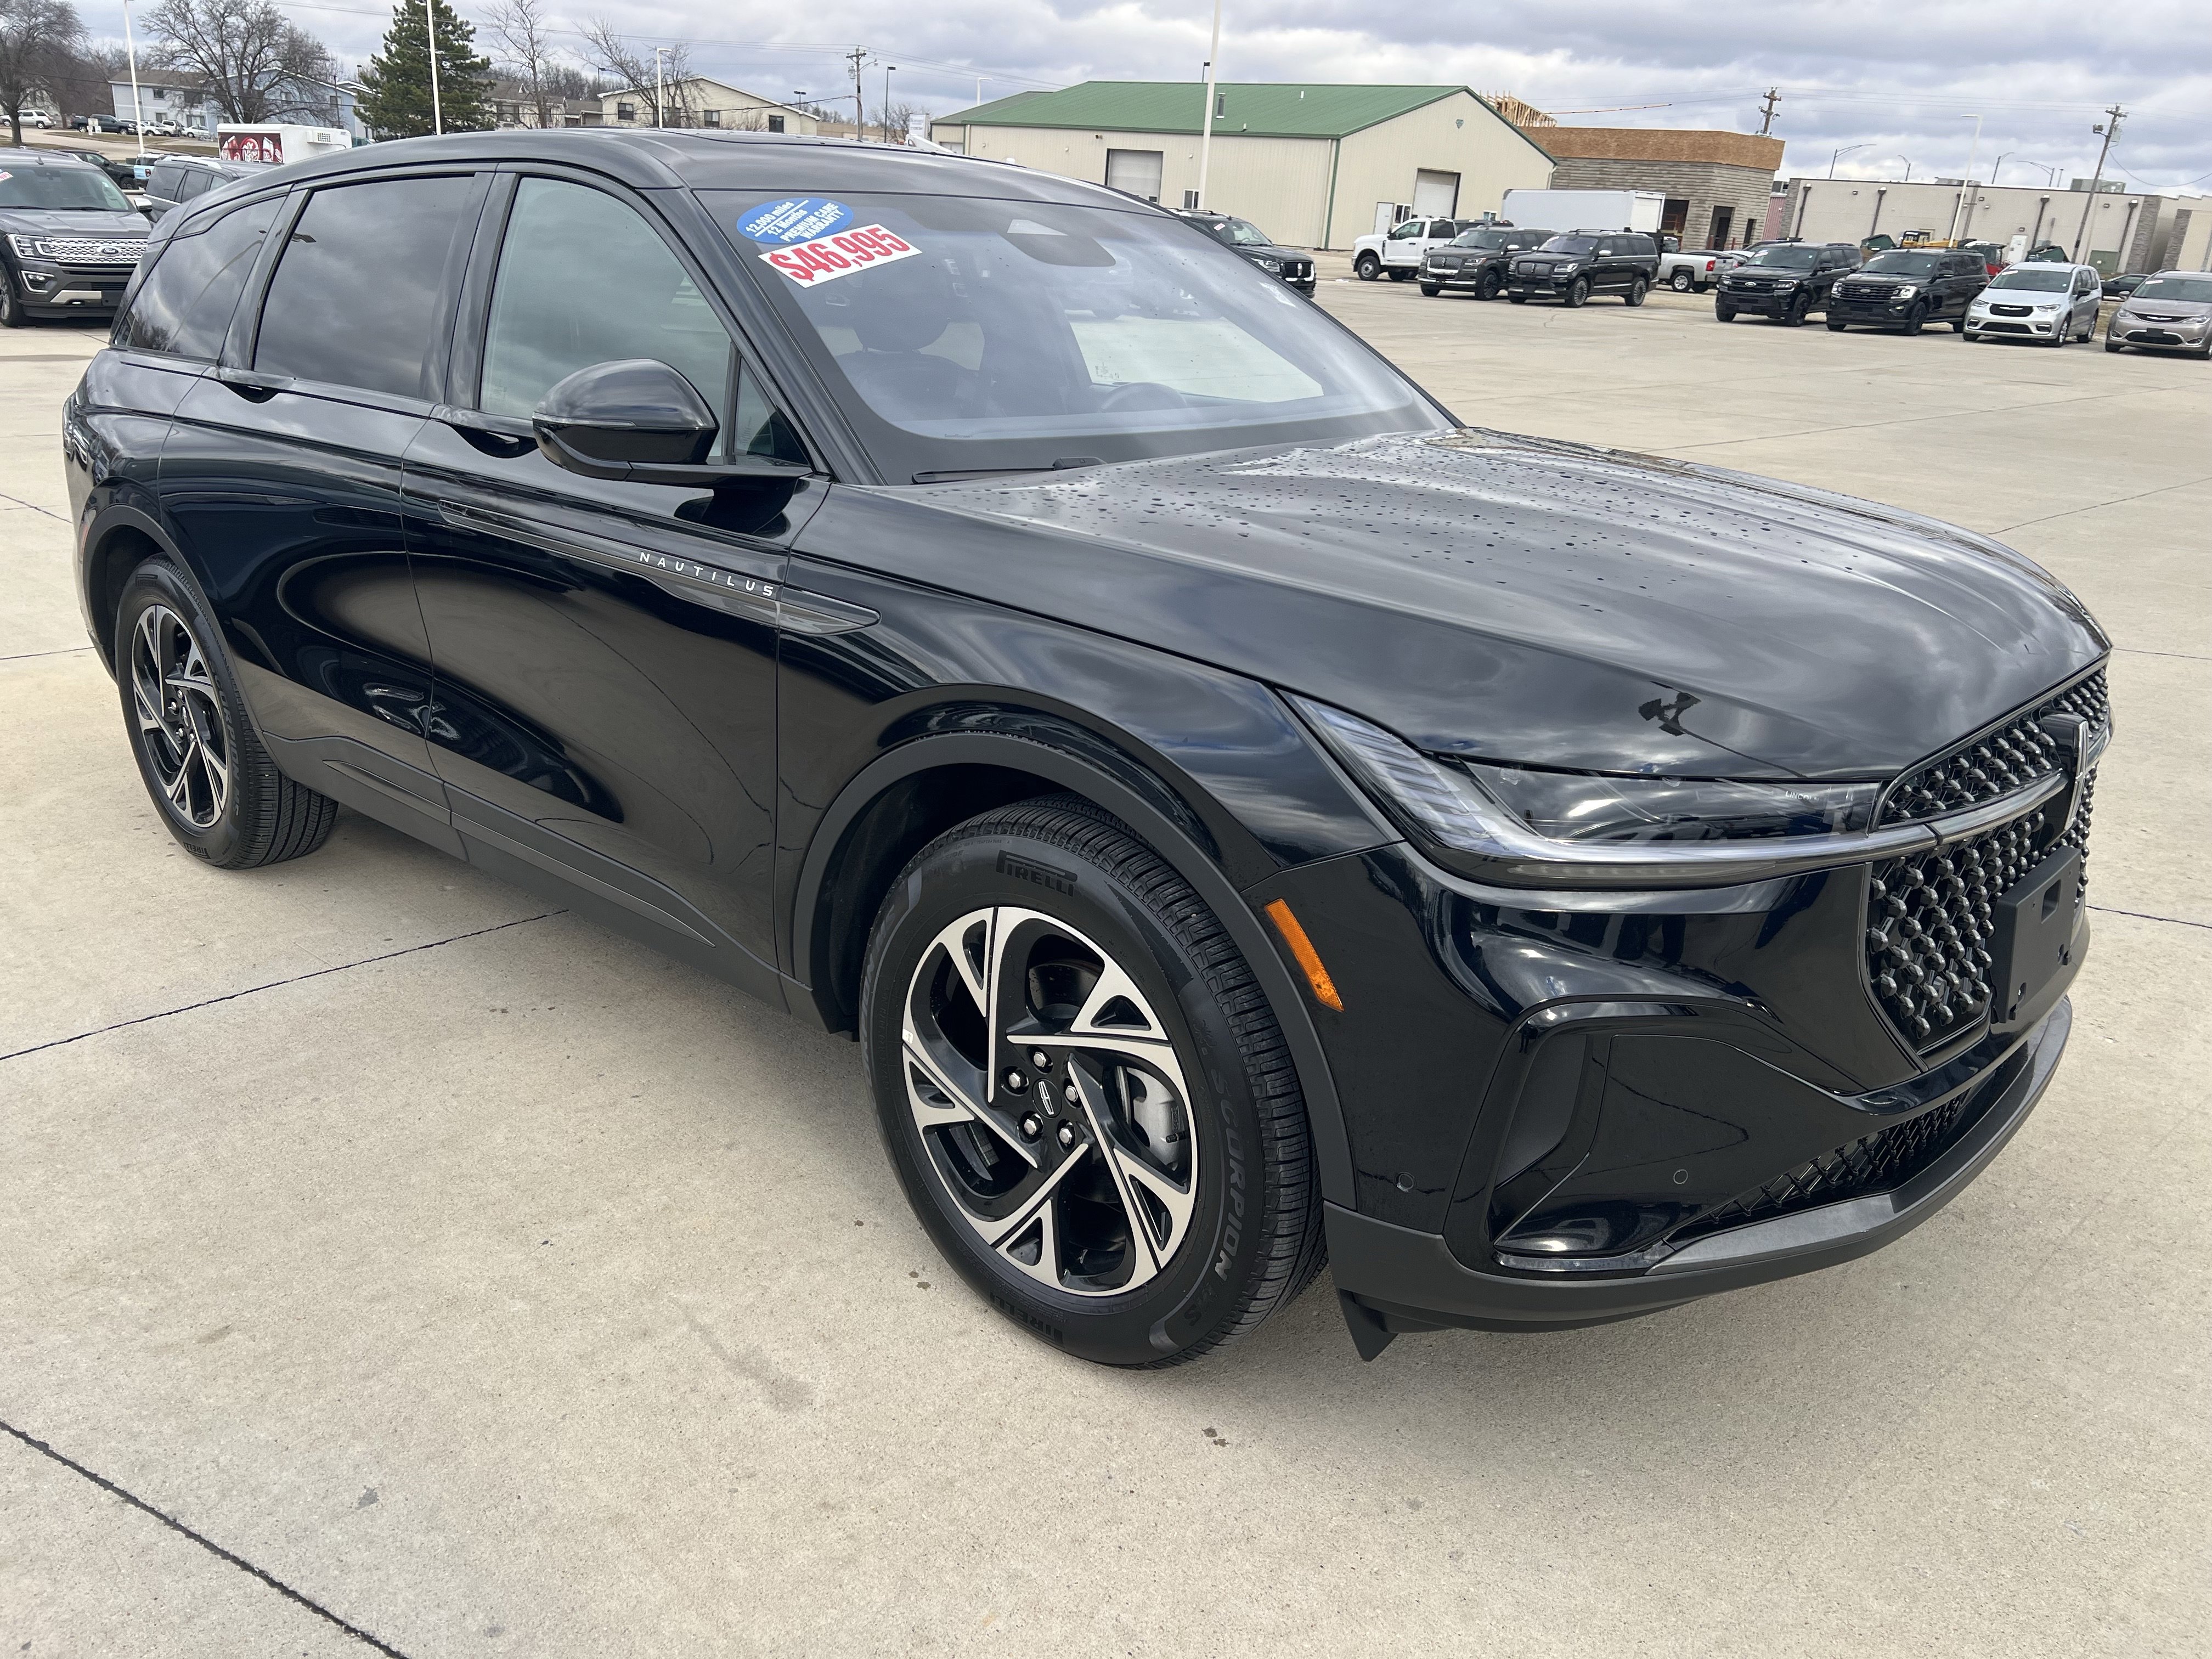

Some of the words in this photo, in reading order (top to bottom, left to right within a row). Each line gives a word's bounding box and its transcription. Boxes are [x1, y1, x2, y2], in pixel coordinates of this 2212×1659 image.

[746, 213, 776, 233] 12,000
[771, 201, 795, 217] miles
[768, 226, 783, 235] 12
[776, 209, 808, 229] Months
[780, 215, 818, 242] PREMIUM
[814, 202, 839, 218] CARE
[799, 209, 844, 239] WARRANTY
[769, 227, 911, 282] $46,995
[639, 552, 774, 596] NAUTILUS
[183, 841, 211, 860] PIRELLI
[996, 850, 1078, 897] PIRELLI
[1211, 1069, 1248, 1282] SCORPION
[989, 1291, 1065, 1348] PIRELLI
